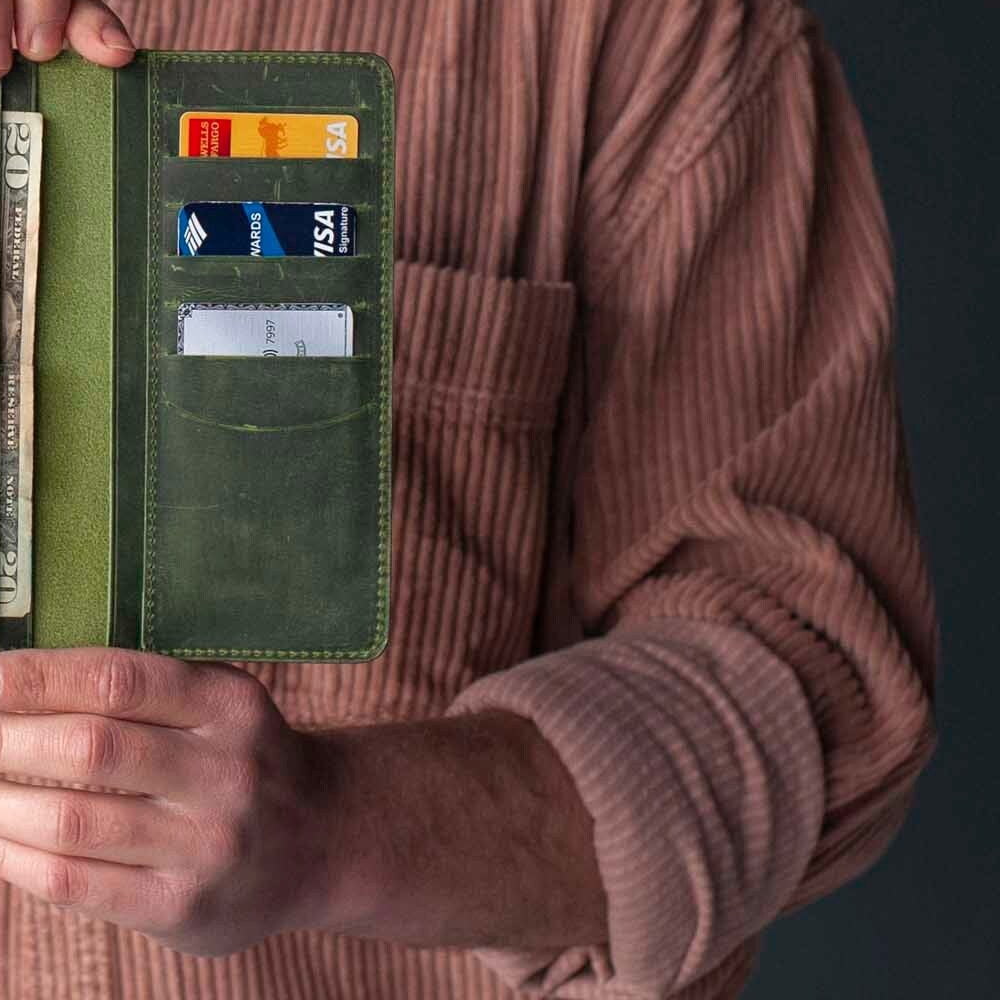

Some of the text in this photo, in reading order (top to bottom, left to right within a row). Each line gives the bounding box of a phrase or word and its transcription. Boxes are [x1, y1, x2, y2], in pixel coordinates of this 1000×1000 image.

[5, 123, 31, 190] 20
[200, 121, 209, 158] WELLS
[11, 207, 22, 280] FEDERAL
[339, 206, 350, 254] Signature
[265, 319, 277, 345] 7997
[6, 475, 14, 517] NOTE
